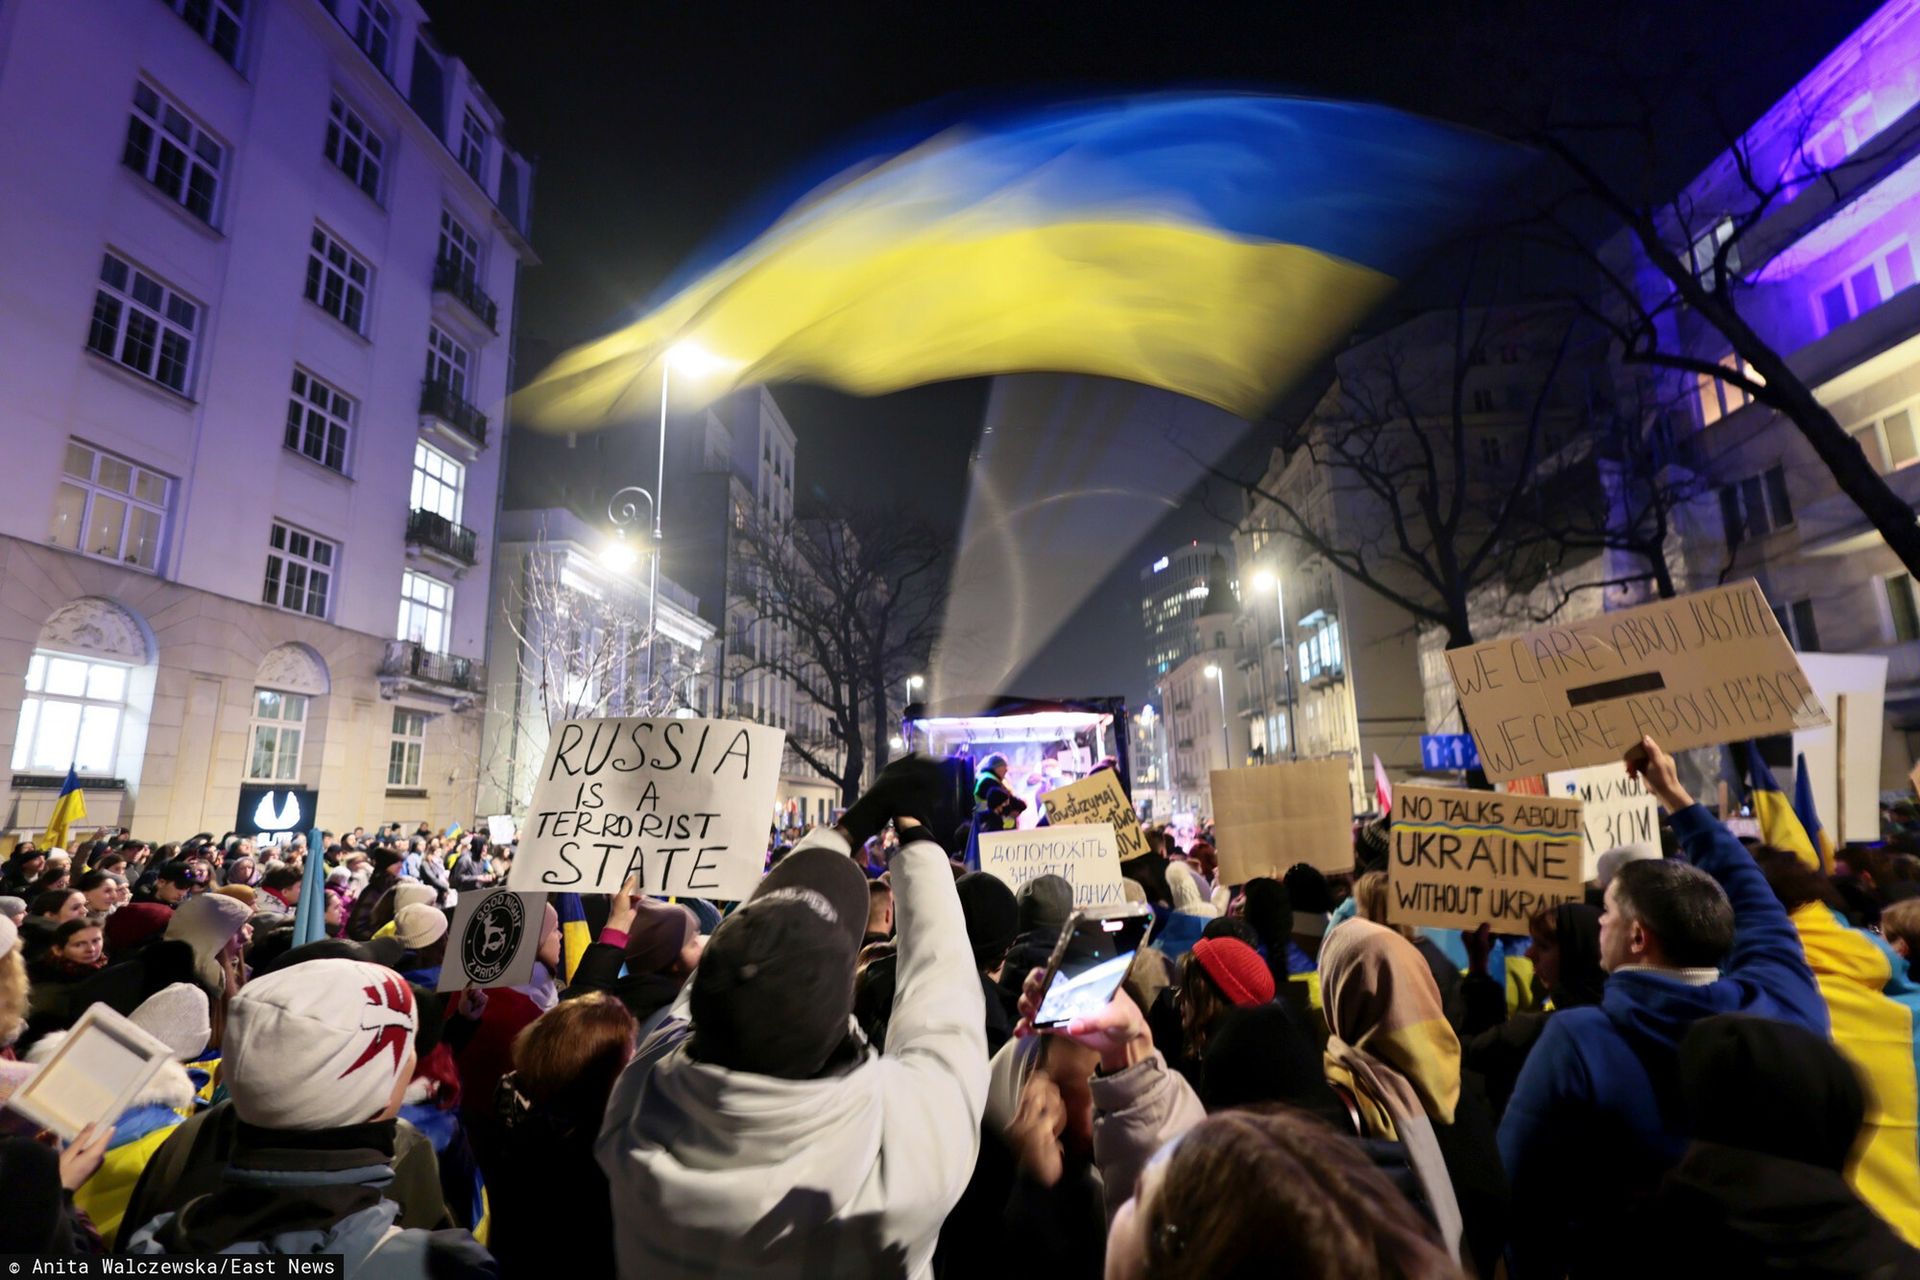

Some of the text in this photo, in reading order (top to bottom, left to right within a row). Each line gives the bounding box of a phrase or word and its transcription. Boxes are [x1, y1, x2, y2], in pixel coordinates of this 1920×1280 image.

[1447, 588, 1781, 696] WE CARE ABOUT JUSTICE
[1474, 666, 1825, 774] WE CARE ABOUT PEACE
[549, 722, 751, 782] RUSSIA
[575, 780, 660, 811] IS A
[1401, 795, 1583, 830] NO TALKS ABOUT
[537, 811, 721, 840] TERRORIST
[541, 841, 728, 891] STATE
[1396, 830, 1569, 881] UKRAINE
[476, 894, 521, 928] GOOD NIGHT
[1395, 881, 1484, 916] WITHOUT
[467, 958, 501, 978] Z PRIDE
